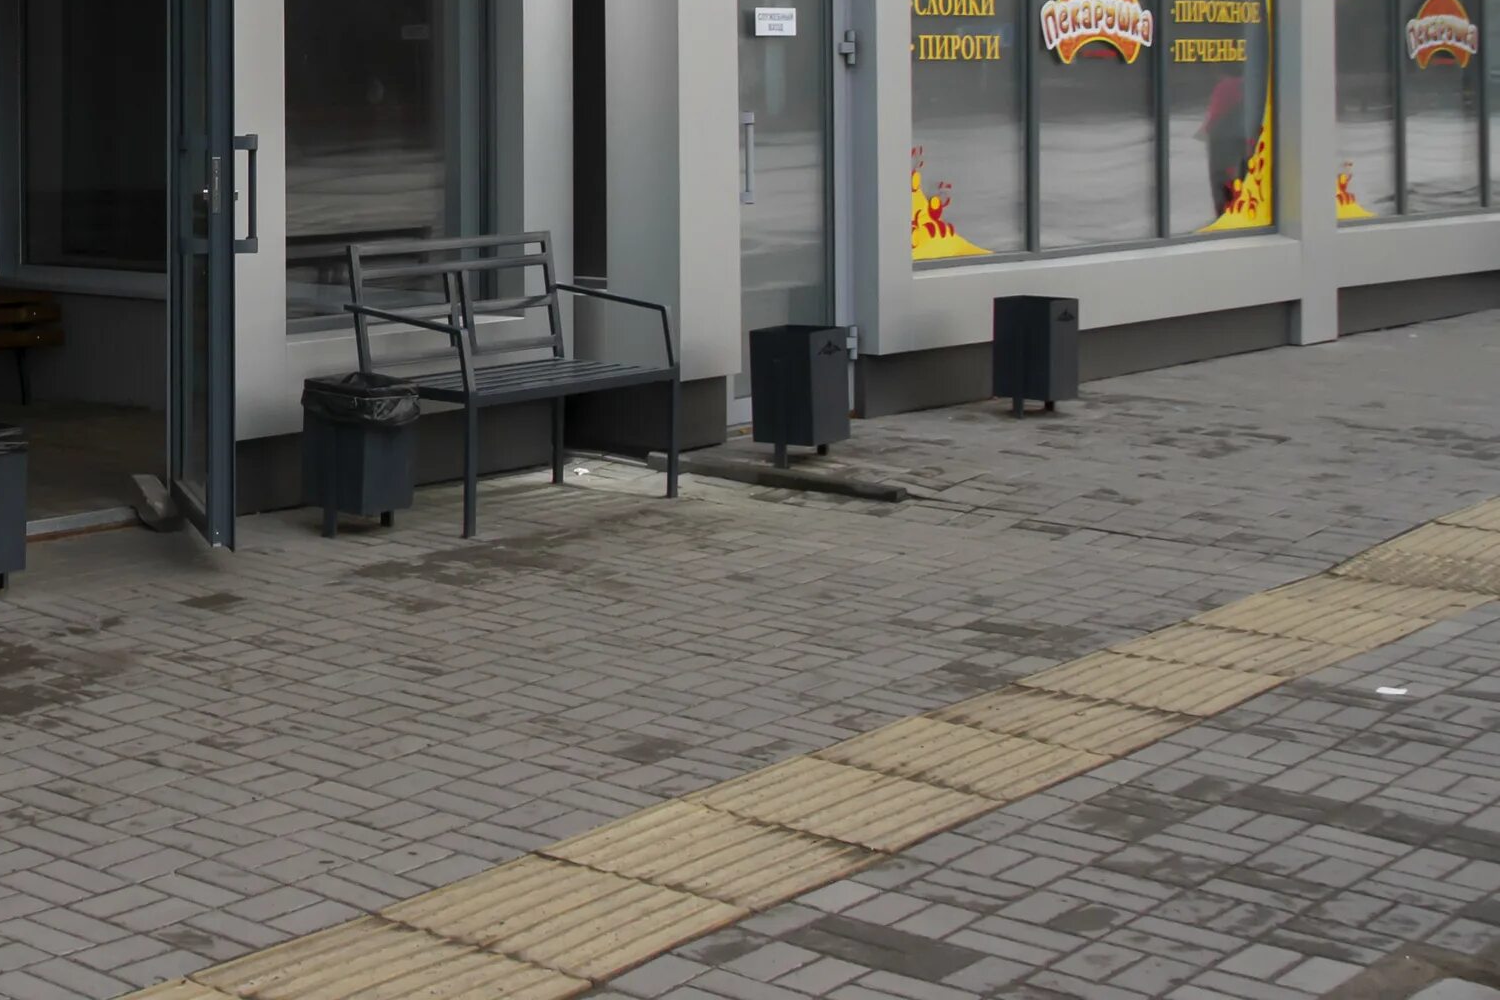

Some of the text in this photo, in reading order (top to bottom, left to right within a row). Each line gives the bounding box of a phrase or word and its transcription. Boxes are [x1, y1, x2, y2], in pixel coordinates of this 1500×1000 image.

[1174, 0, 1260, 23] ПИРОЖНОЕ
[918, 34, 1001, 60] ПИРОГИ
[1174, 39, 1247, 62] ПЕЧЕНЬЕ
